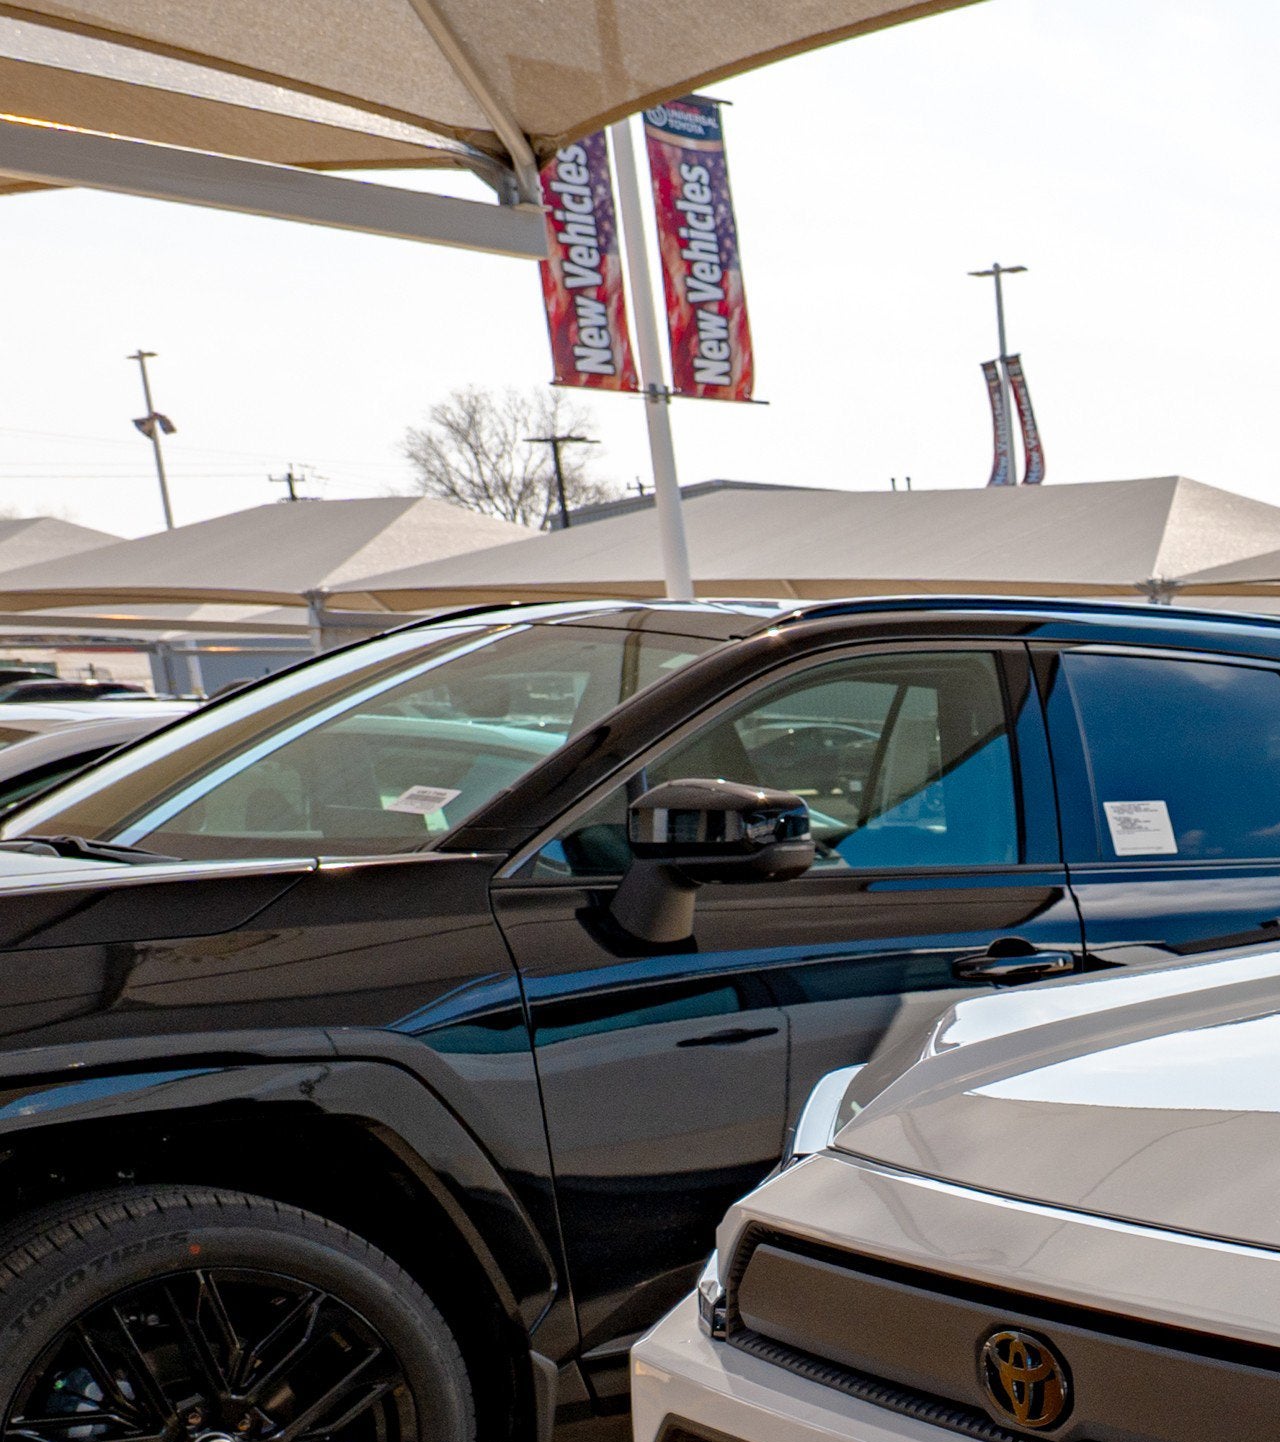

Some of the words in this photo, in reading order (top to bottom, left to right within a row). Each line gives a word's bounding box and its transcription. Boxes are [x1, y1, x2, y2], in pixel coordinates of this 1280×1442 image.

[551, 144, 603, 289] Vehicles
[675, 163, 726, 304] Vehicles
[572, 295, 616, 376] New
[692, 309, 732, 386] New
[9, 1268, 87, 1334] TOYO
[89, 1231, 190, 1272] TIRES
